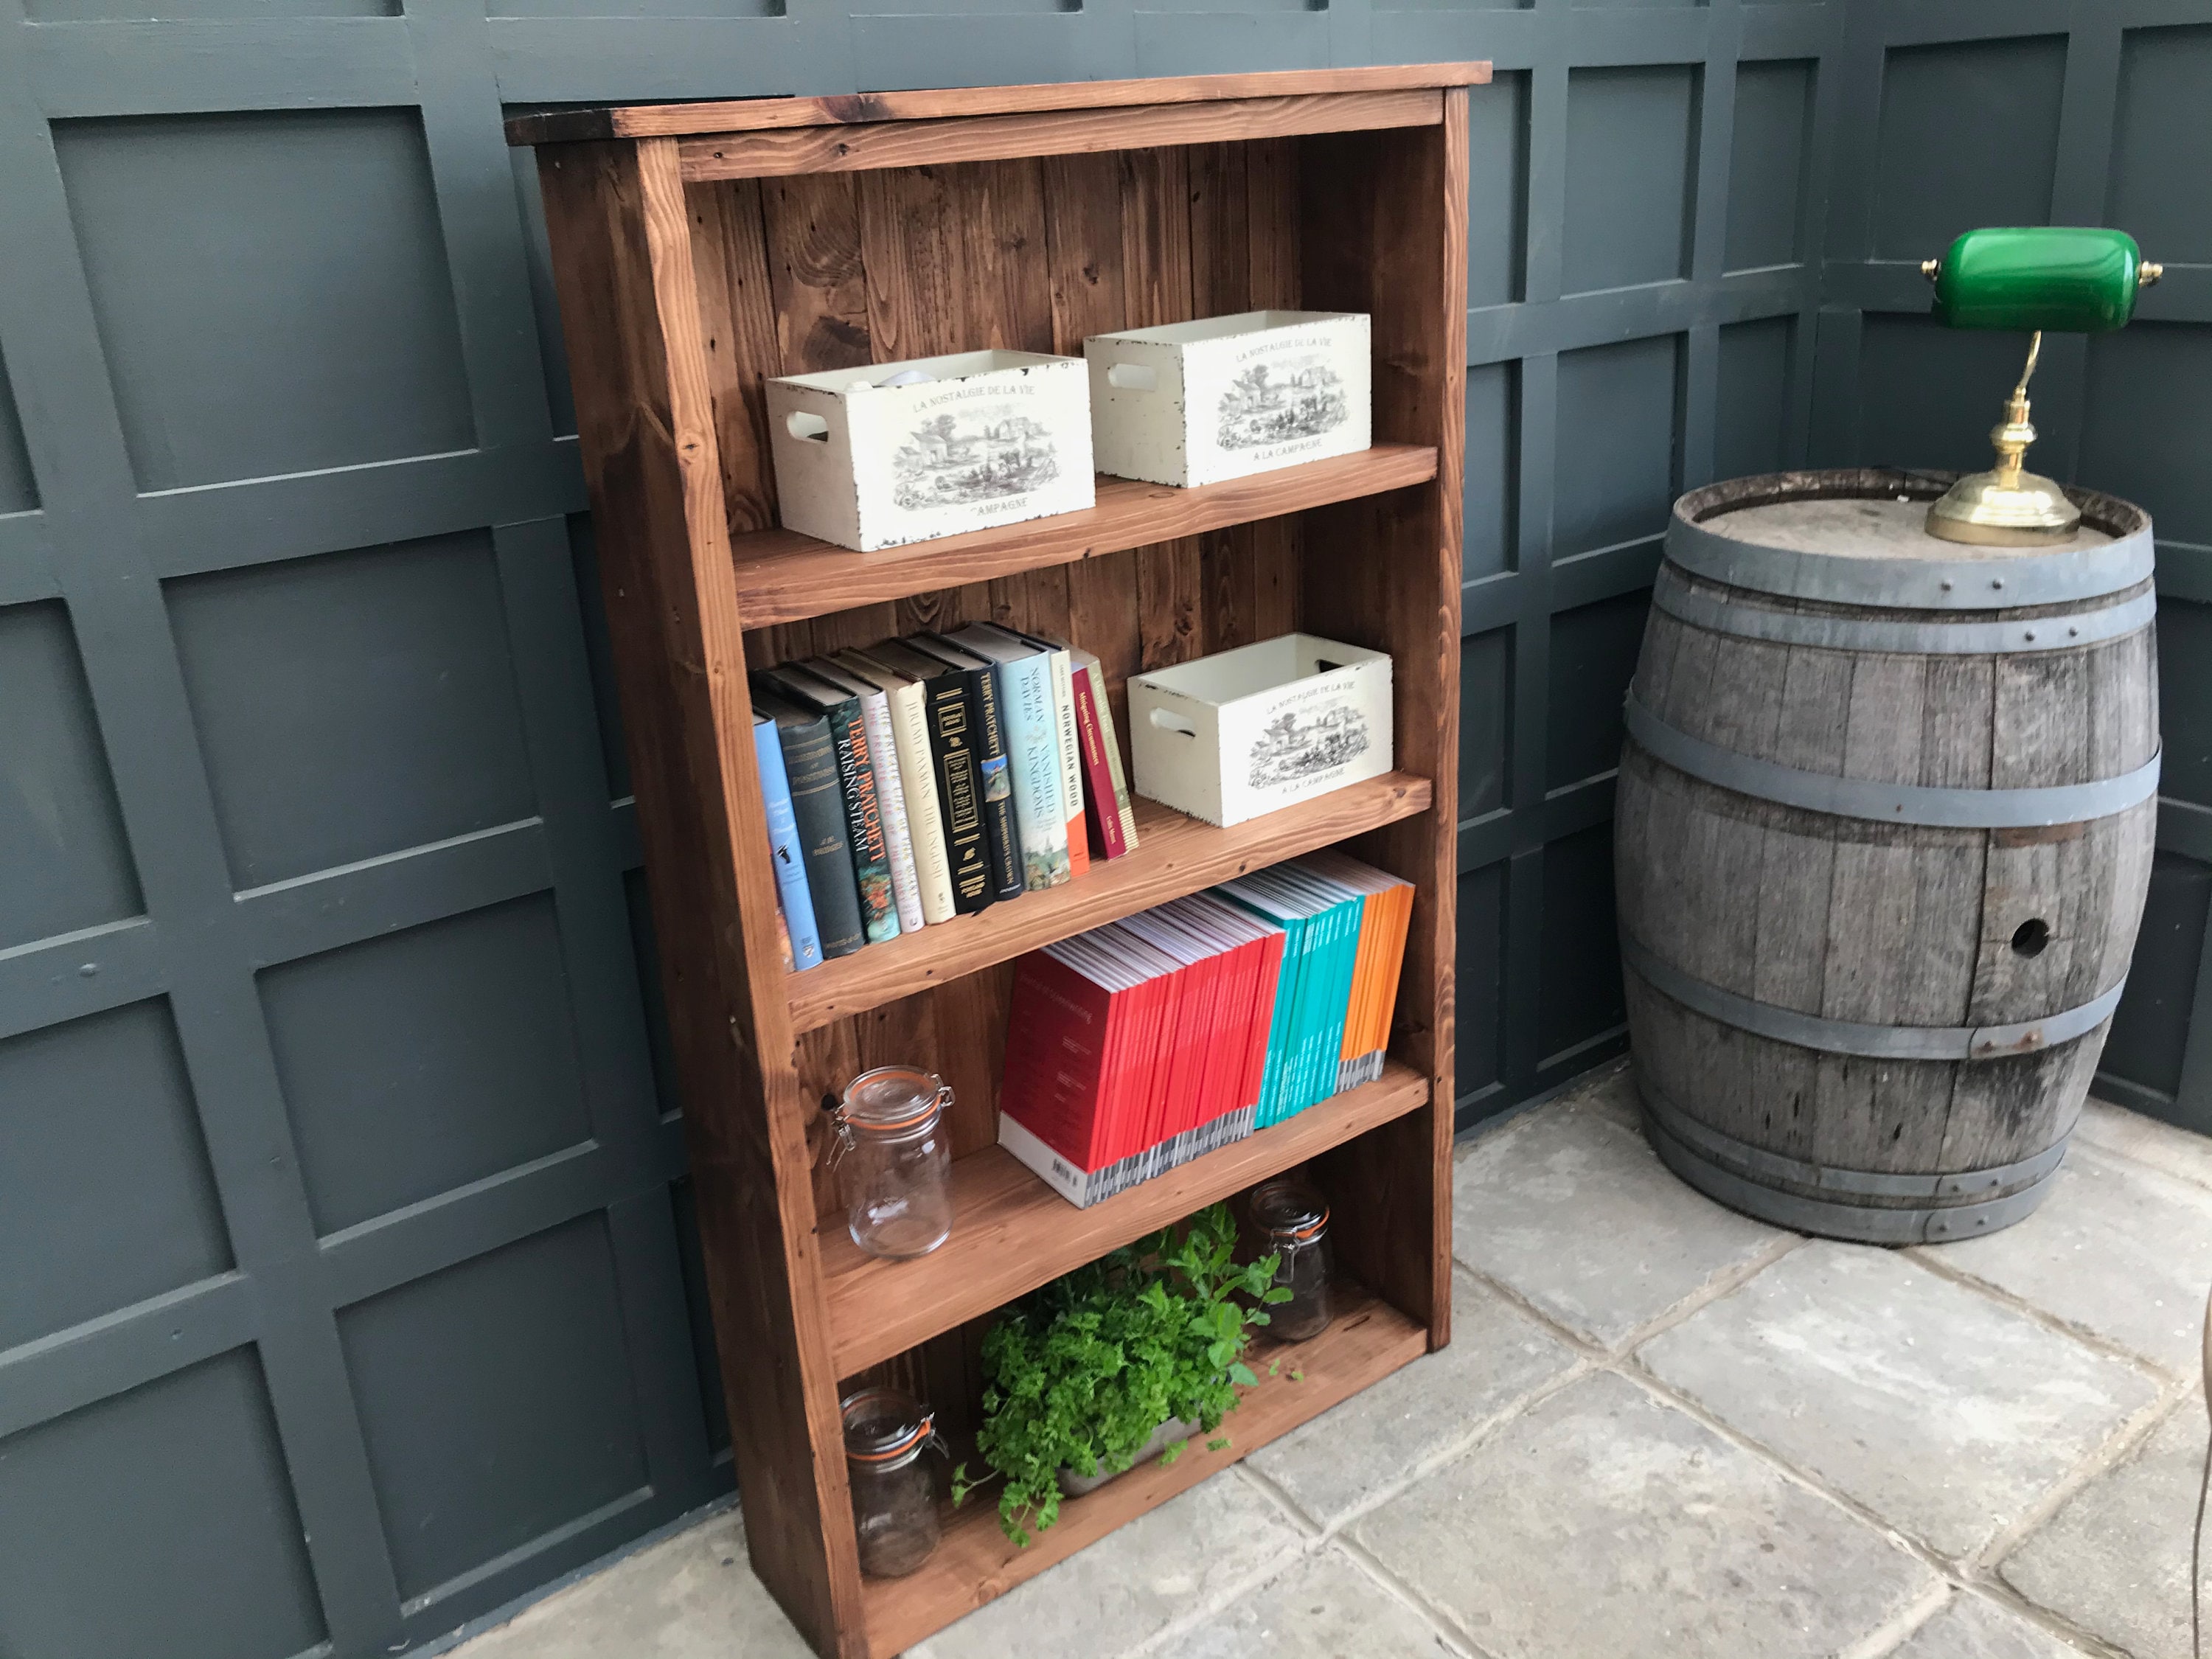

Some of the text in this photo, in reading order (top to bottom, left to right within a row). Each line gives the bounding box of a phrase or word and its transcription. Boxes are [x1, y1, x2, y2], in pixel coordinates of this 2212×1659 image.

[1236, 336, 1332, 363] LA NOSTALGIE DE LA VIE
[913, 383, 1035, 413] LA NOSTALGIE DE LA VIE
[1262, 450, 1273, 460] LA
[1276, 438, 1322, 457] CAMPAGNE
[980, 672, 1001, 756] TERRY PRATCHETT
[1020, 676, 1032, 722] DAVIES
[1031, 667, 1045, 723] NORMAN
[1078, 691, 1099, 766] Mitigating Circumstances
[848, 714, 887, 863] TERRY PRATCHETT
[906, 701, 944, 880] JEREMY PAXMAN THE ENGLISH
[1027, 745, 1045, 819] KINGDOMS
[1040, 743, 1056, 814] VANISHED
[1062, 703, 1079, 807] NORWEGIAN WOOD
[838, 737, 870, 852] RAISING STEAM
[998, 800, 1006, 816] THE
[1004, 856, 1015, 885] CROWN
